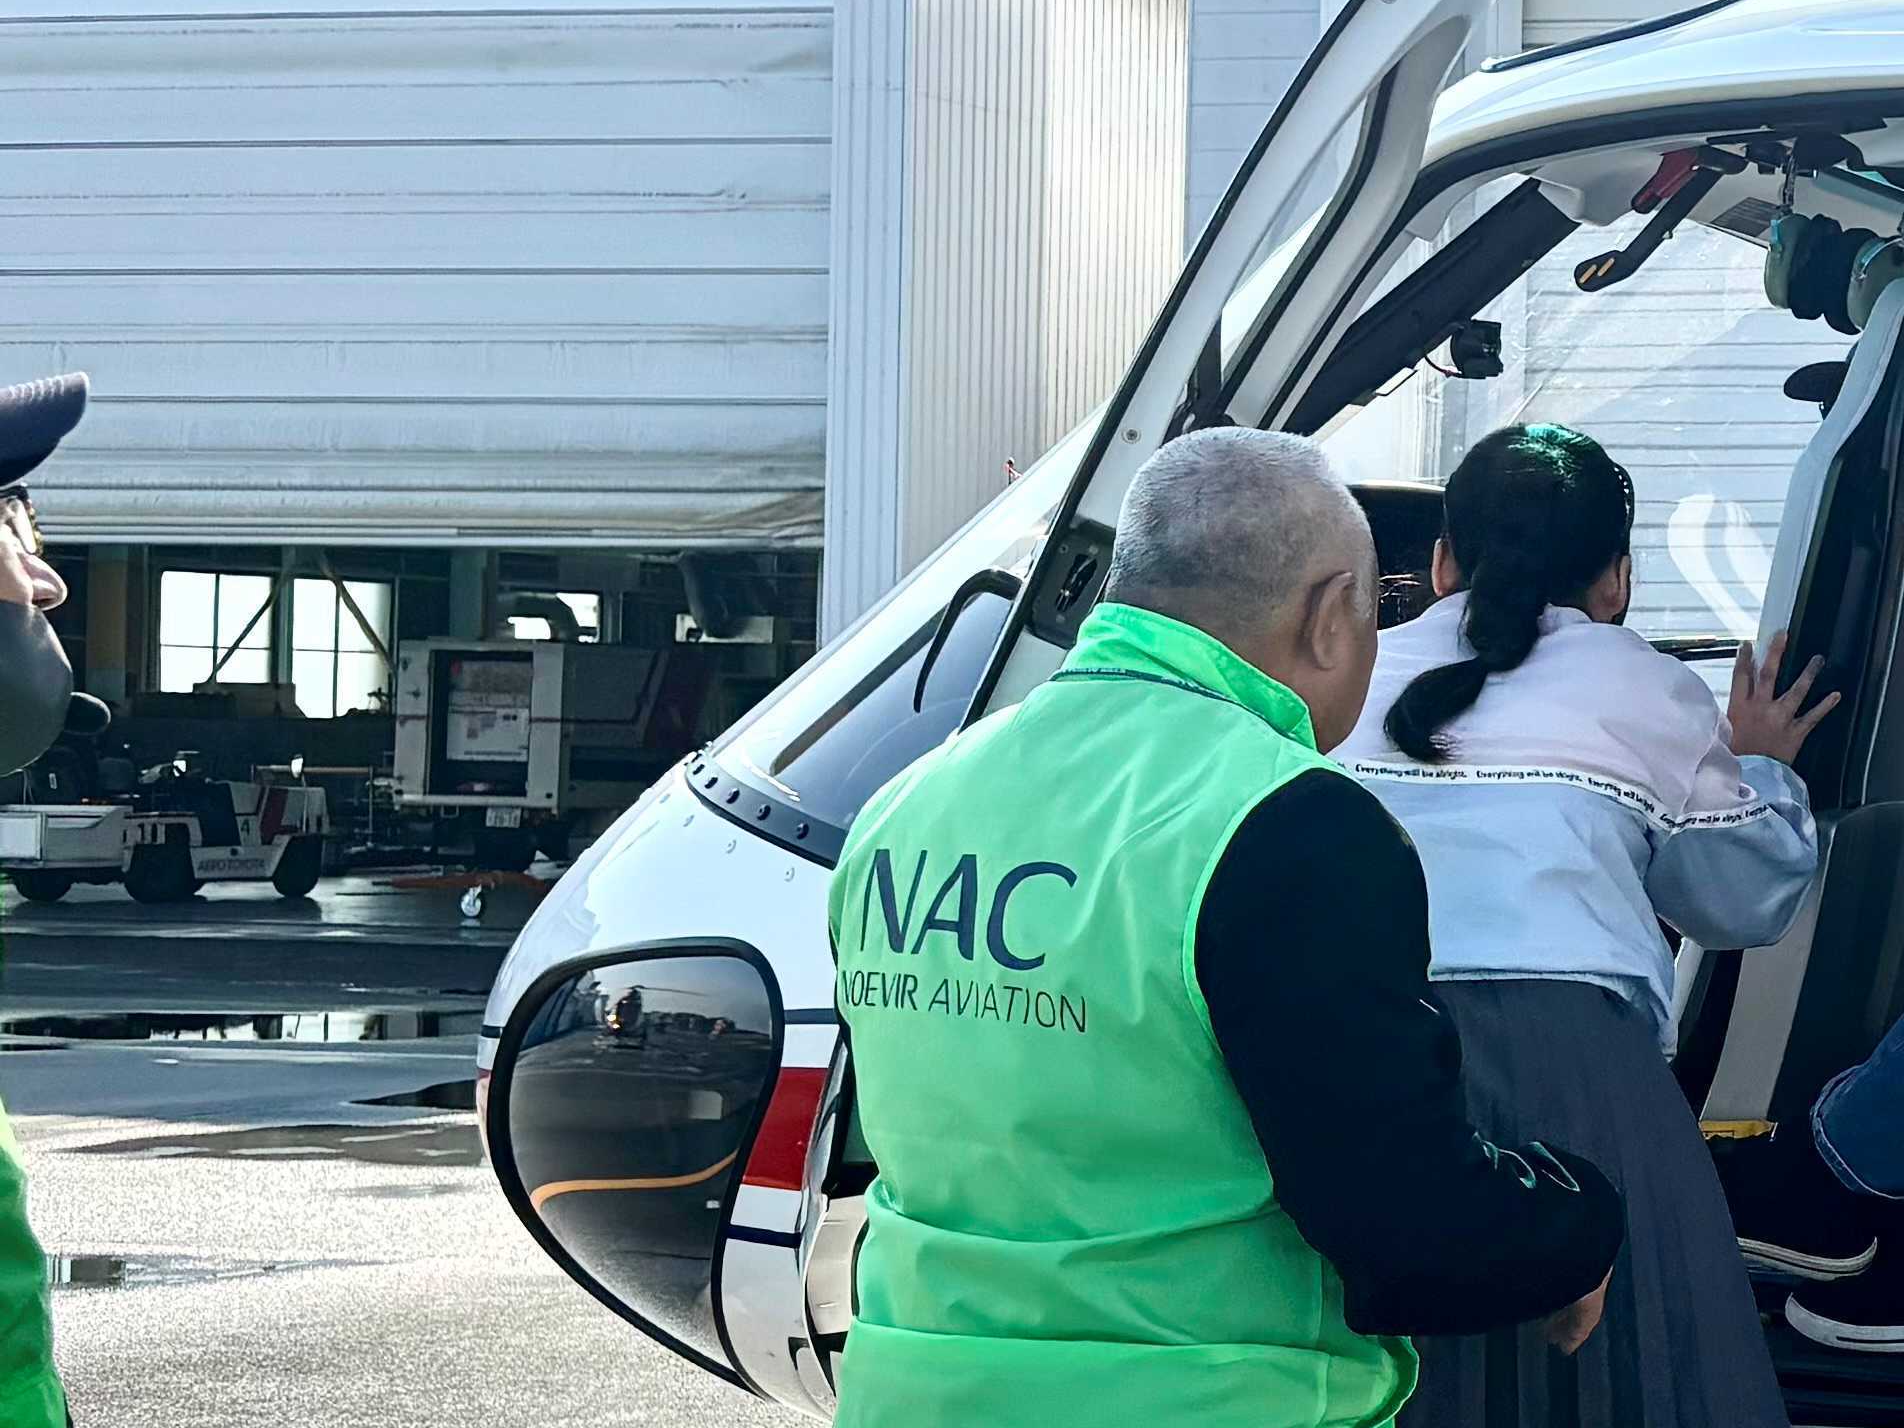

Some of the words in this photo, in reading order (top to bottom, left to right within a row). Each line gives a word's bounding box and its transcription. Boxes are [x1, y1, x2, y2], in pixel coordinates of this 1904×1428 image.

[860, 848, 1078, 971] NAC
[842, 970, 918, 1011] NOEVIR
[928, 978, 1086, 1033] AVIATION
